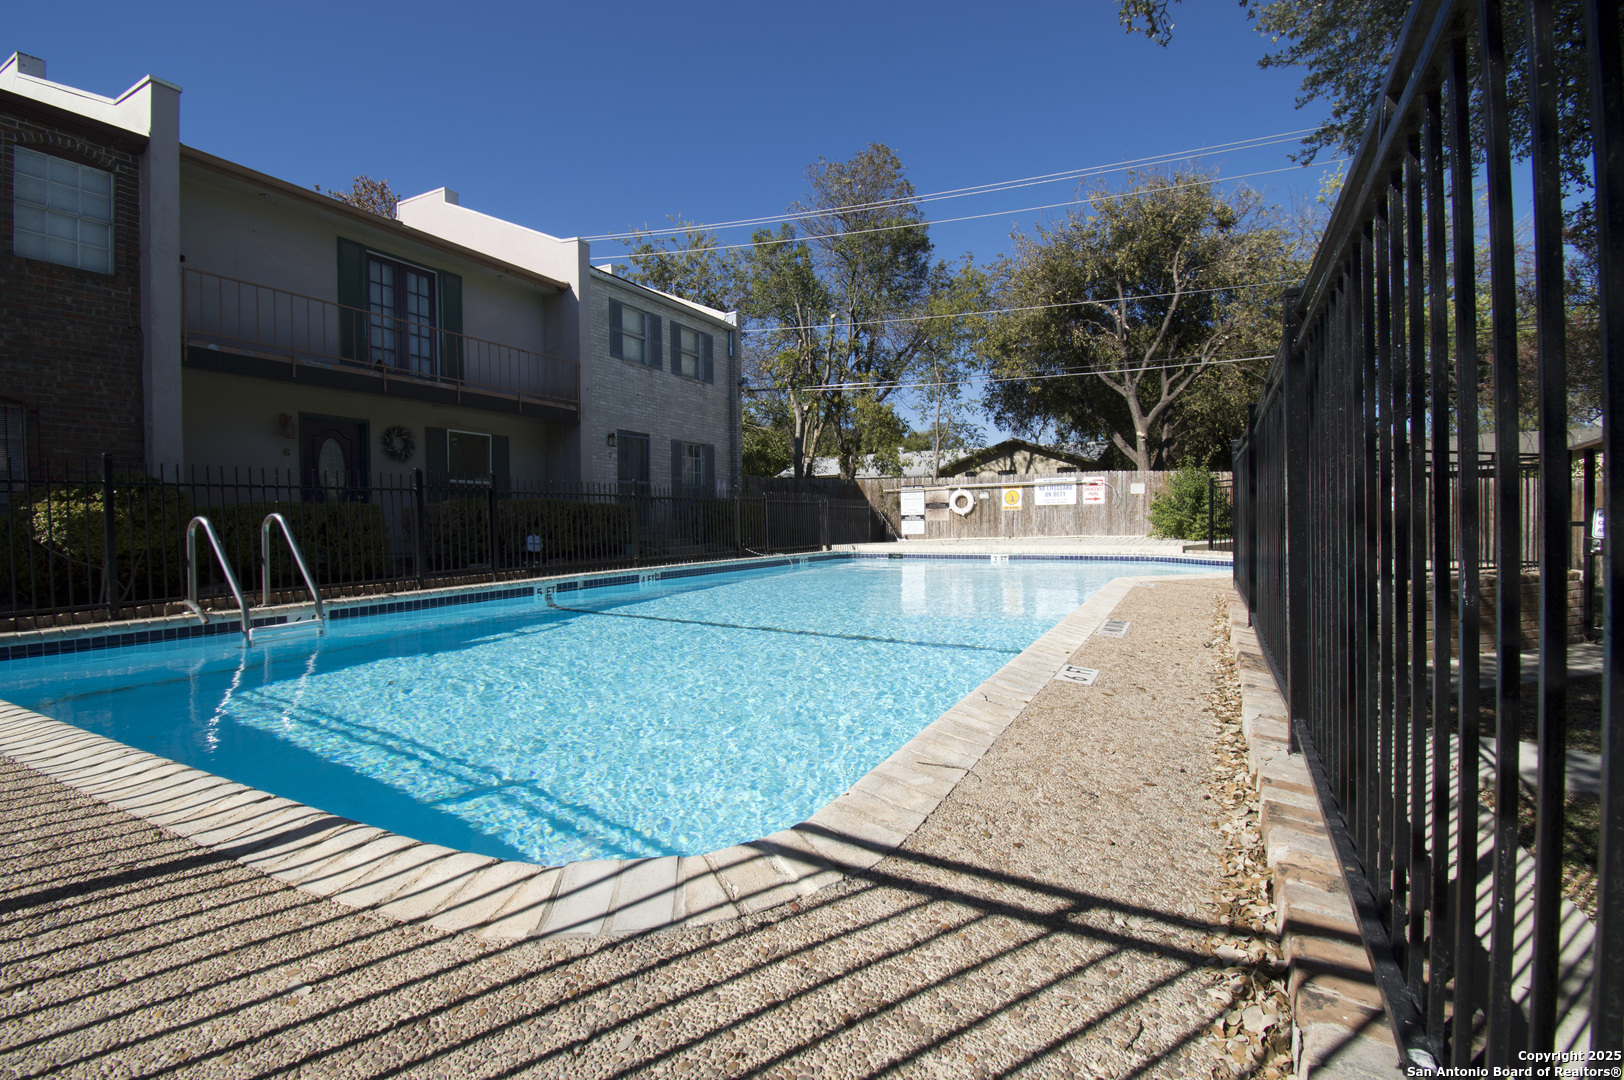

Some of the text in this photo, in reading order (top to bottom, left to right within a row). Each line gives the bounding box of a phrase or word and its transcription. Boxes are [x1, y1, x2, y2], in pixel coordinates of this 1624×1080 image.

[283, 448, 290, 457] 6
[1046, 483, 1073, 491] LIFEGUARD
[547, 586, 556, 595] FT
[1065, 666, 1094, 675] FT
